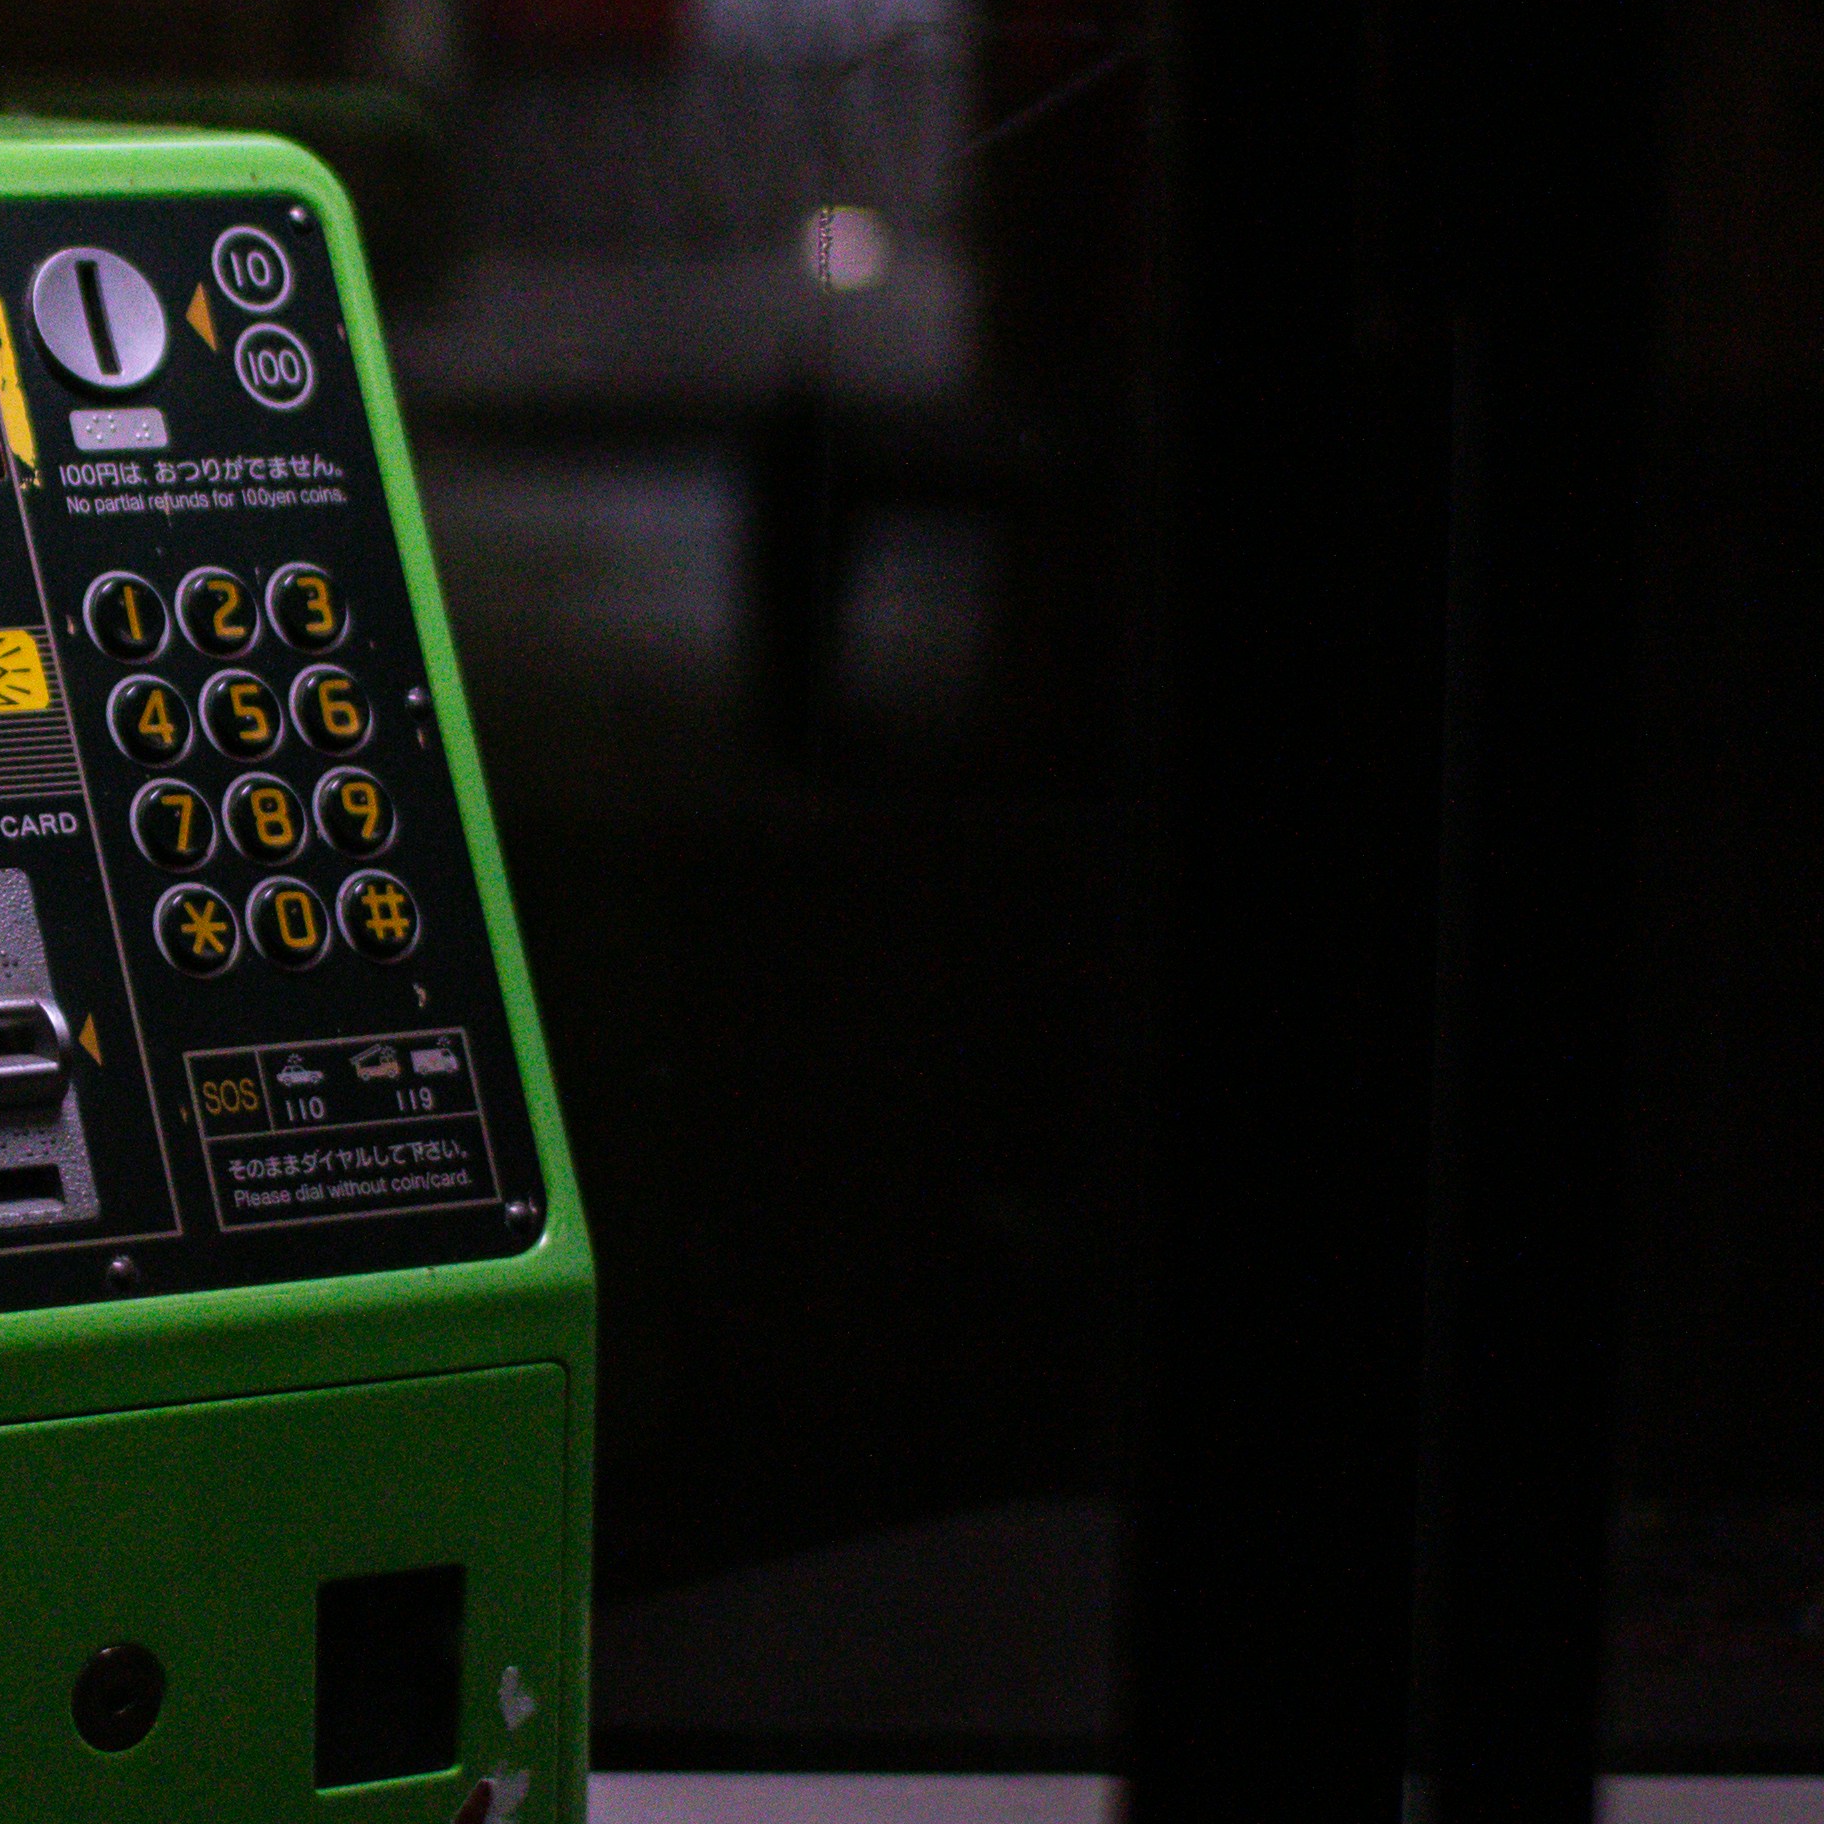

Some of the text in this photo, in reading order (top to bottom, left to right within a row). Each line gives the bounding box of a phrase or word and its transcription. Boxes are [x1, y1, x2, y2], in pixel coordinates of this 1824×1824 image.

[230, 250, 271, 288] 10
[247, 348, 301, 387] 100
[66, 496, 91, 514] No
[94, 492, 145, 516] partial
[148, 489, 209, 512] refunds
[211, 489, 237, 508] for
[241, 488, 296, 509] 100yen
[122, 576, 335, 641] 1 2 3
[138, 678, 360, 745] 4 5 6
[0, 811, 78, 838] CARD
[160, 782, 381, 852] 7 8 9
[275, 890, 318, 948] 0
[201, 1077, 260, 1116] SOS
[285, 1095, 325, 1123] 110
[396, 1086, 434, 1112] 119
[233, 1187, 292, 1208] Please
[295, 1182, 325, 1202] dial
[326, 1176, 388, 1199] without
